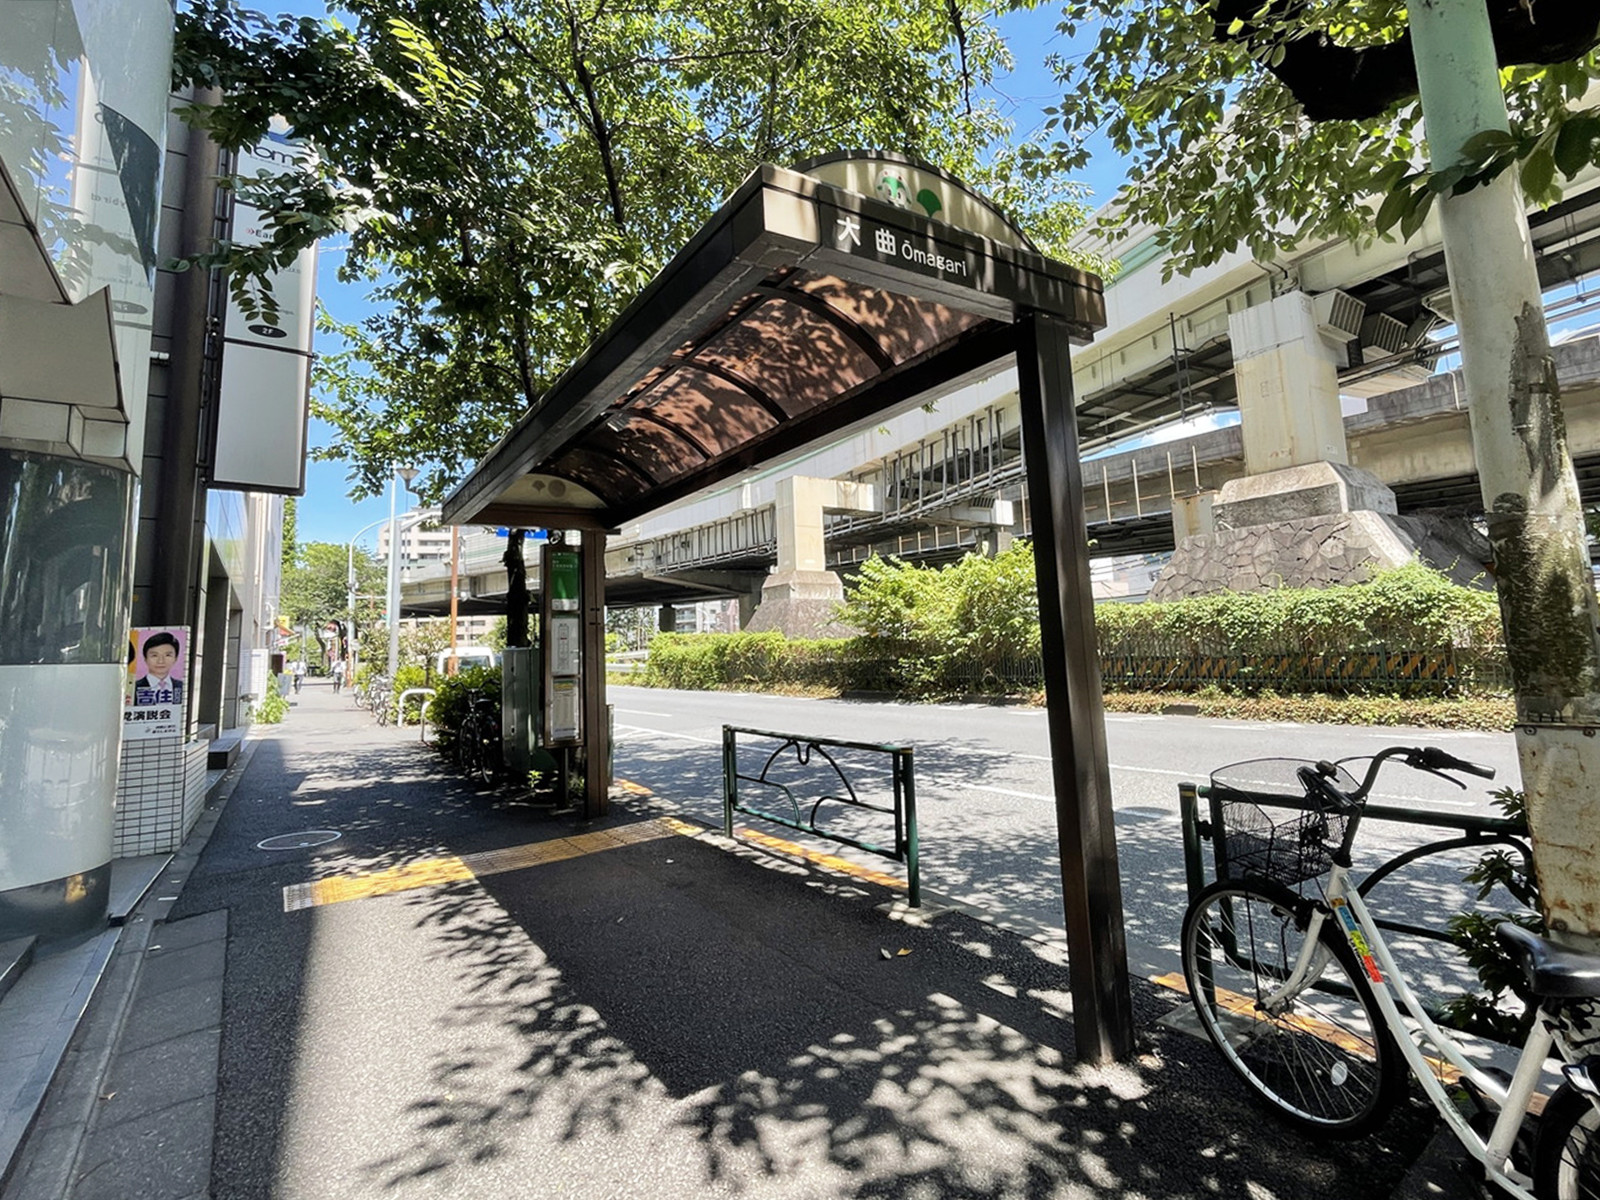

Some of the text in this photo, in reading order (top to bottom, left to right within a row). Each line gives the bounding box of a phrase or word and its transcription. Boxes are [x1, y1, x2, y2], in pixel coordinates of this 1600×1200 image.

[836, 216, 967, 277] 大曲 Ōmagari
[137, 688, 173, 705] 吉住
